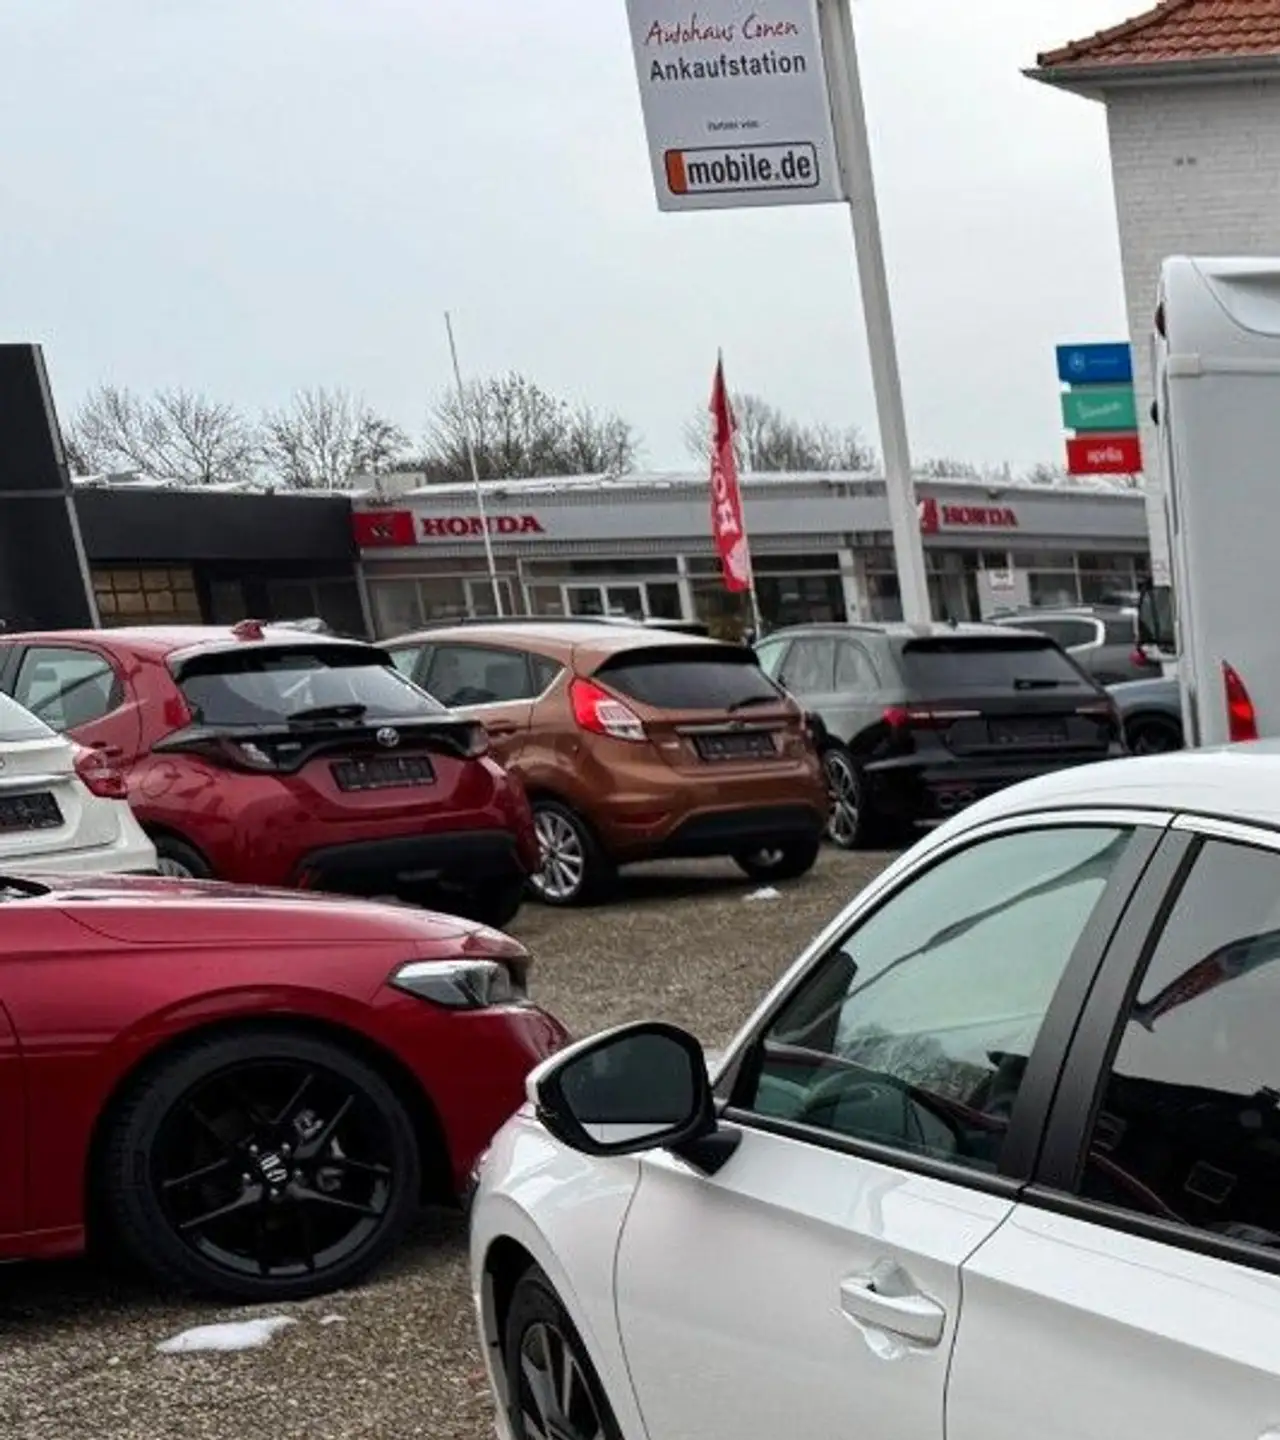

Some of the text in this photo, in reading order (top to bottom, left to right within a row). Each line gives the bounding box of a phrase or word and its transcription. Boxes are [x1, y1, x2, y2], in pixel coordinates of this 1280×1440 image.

[644, 13, 799, 46] Autohaus Conen
[650, 50, 807, 82] Ankaufstation
[688, 150, 811, 185] mobile.de
[420, 514, 546, 537] HONDA
[941, 505, 1019, 527] HONDA
